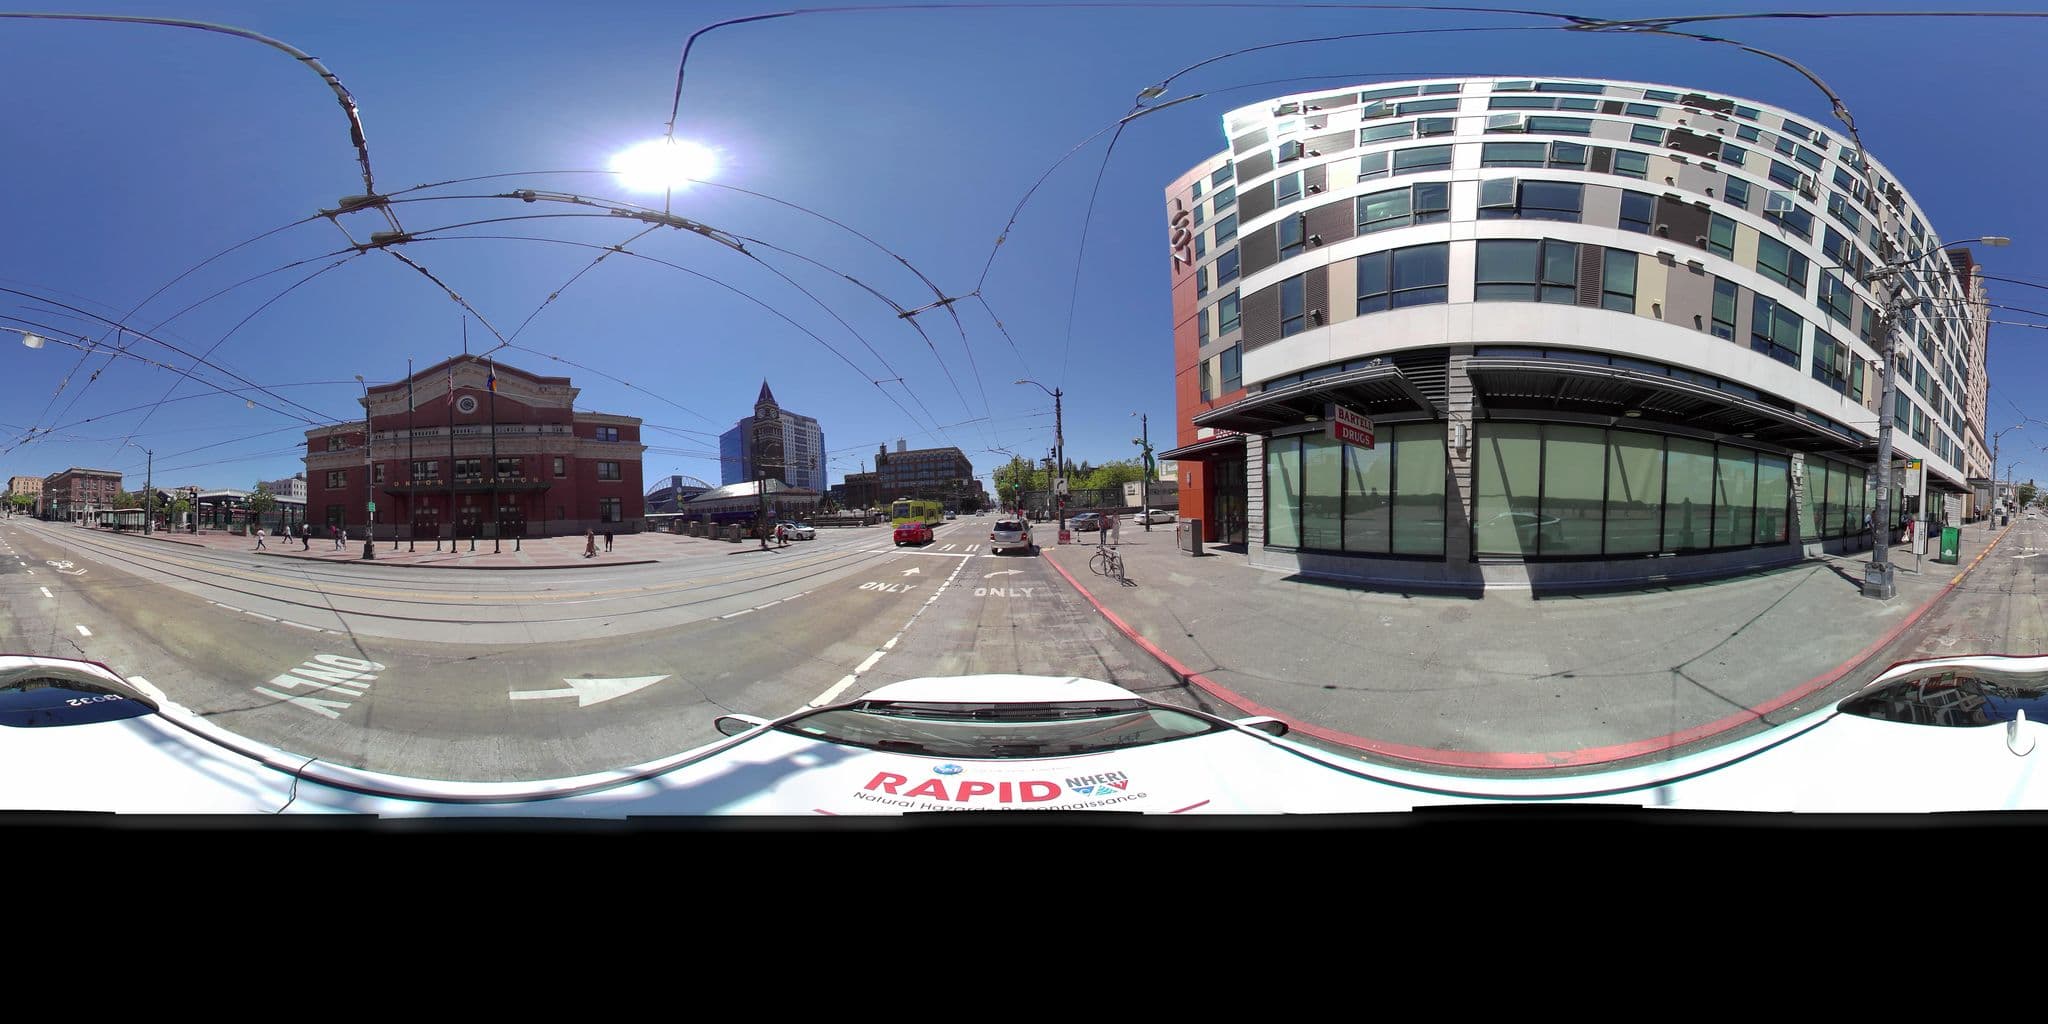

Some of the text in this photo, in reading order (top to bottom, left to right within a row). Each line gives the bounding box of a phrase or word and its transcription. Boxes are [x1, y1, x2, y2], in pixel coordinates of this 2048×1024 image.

[1338, 408, 1373, 431] BARTELL
[1342, 426, 1370, 445] DRUGS
[465, 477, 539, 485] STATION
[858, 582, 918, 594] ONLY
[974, 587, 1034, 598] ONLY
[253, 654, 386, 720] ONLY
[863, 771, 1062, 803] RAPID
[1065, 771, 1128, 788] NHERI
[853, 791, 916, 808] Natural
